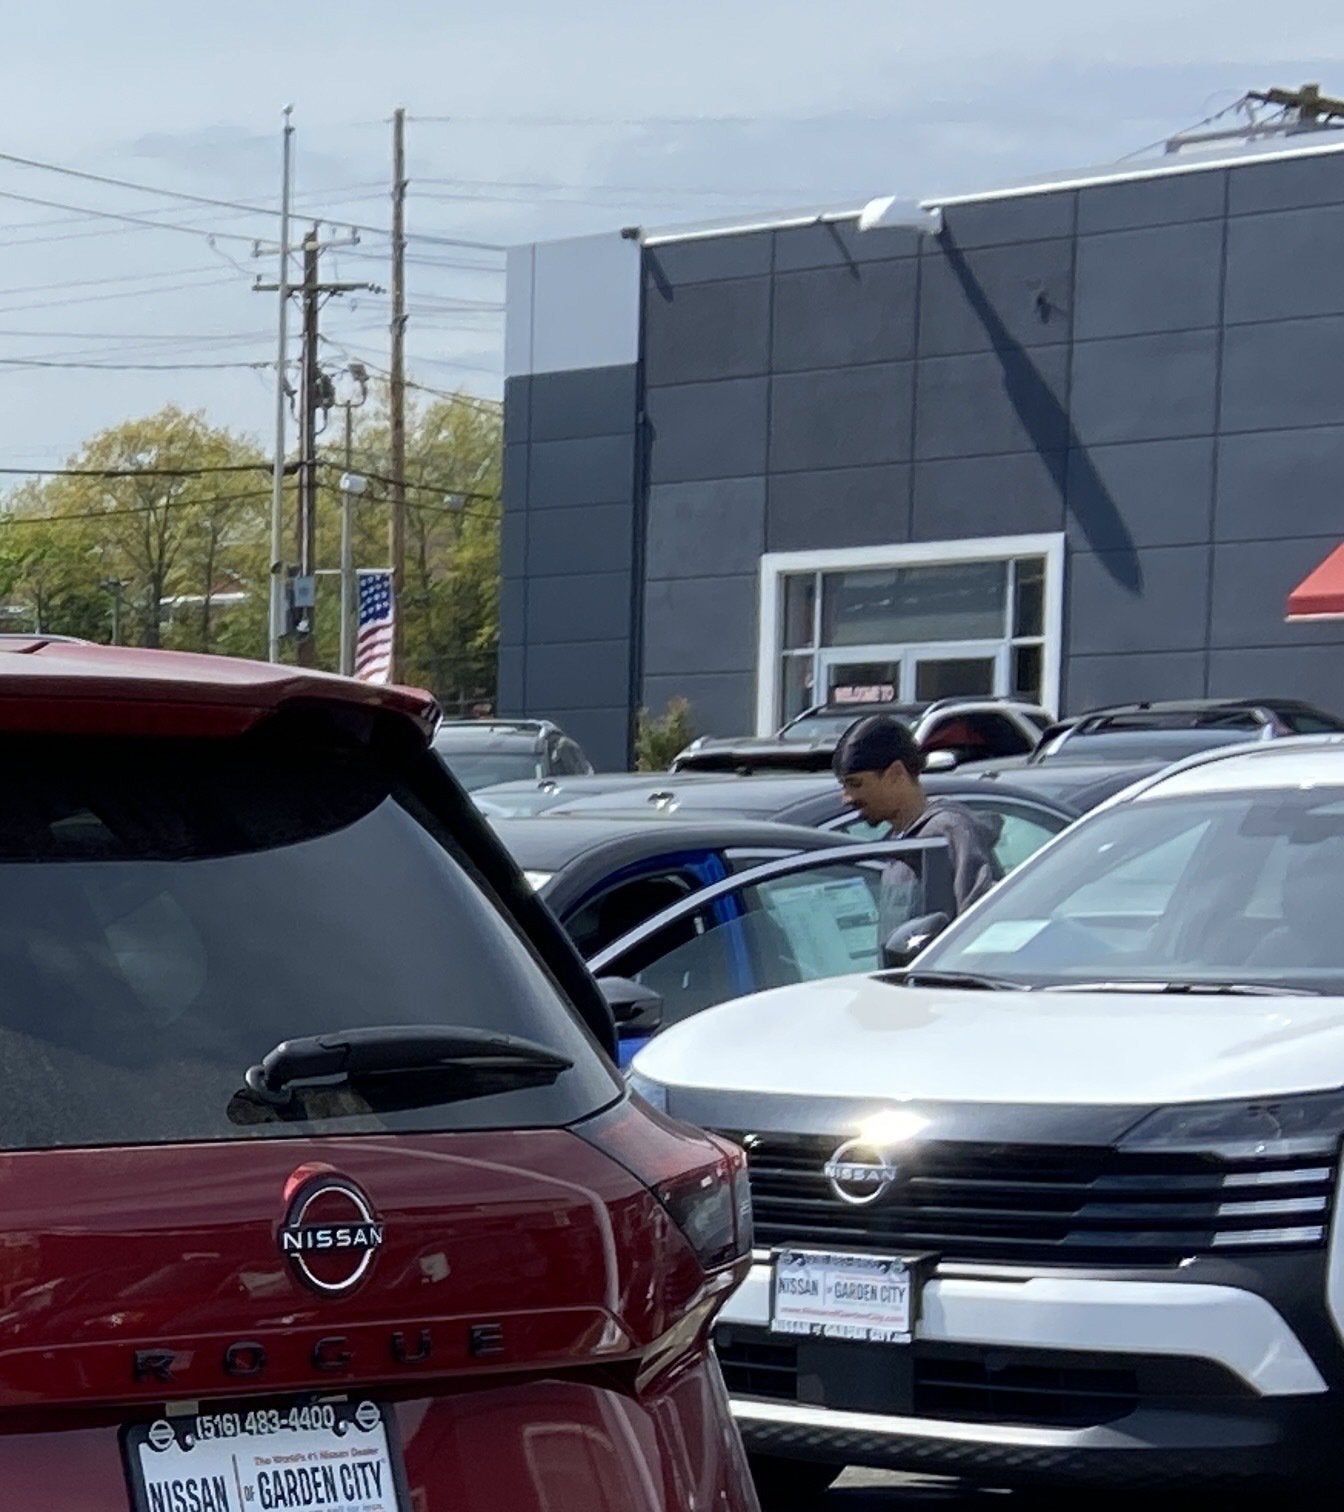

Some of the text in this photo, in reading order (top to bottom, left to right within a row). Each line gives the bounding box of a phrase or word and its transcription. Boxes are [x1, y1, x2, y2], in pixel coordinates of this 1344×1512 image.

[824, 1166, 897, 1181] NISSAN
[282, 1226, 384, 1251] NISSAN
[778, 1276, 819, 1297] NISSAN
[834, 1280, 906, 1304] GARDEN CITY
[133, 1323, 505, 1385] ROGUE
[196, 1404, 336, 1440] (516) 483-4400
[257, 1465, 338, 1510] GARDEN
[339, 1459, 383, 1503] CITY
